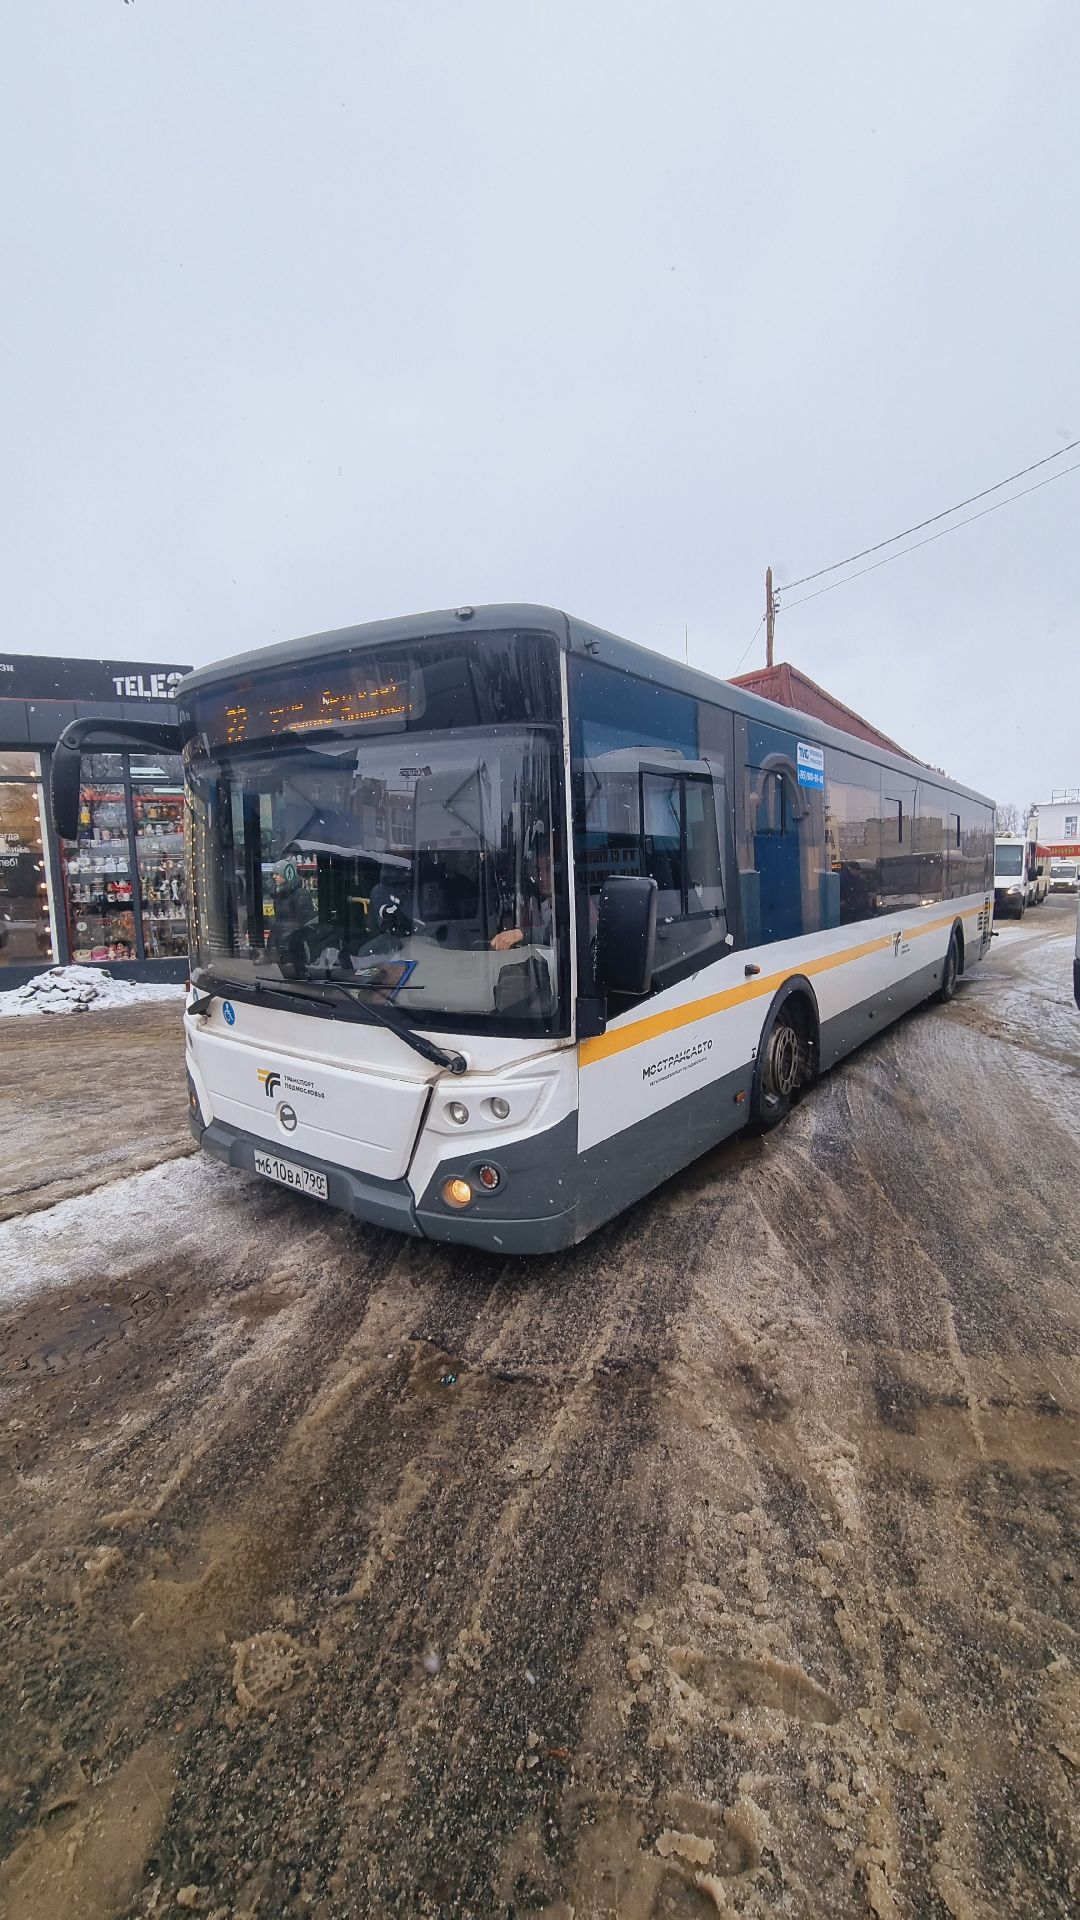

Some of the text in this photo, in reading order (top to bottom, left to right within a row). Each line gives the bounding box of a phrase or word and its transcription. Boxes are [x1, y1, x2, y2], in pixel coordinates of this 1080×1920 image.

[642, 1040, 713, 1080] МОСТРАНСАВТО
[284, 1075, 315, 1089] ТРАНСПОРТ
[284, 1083, 326, 1099] ПОДМОСКОВЬЯ
[256, 1158, 302, 1188] М610ВА
